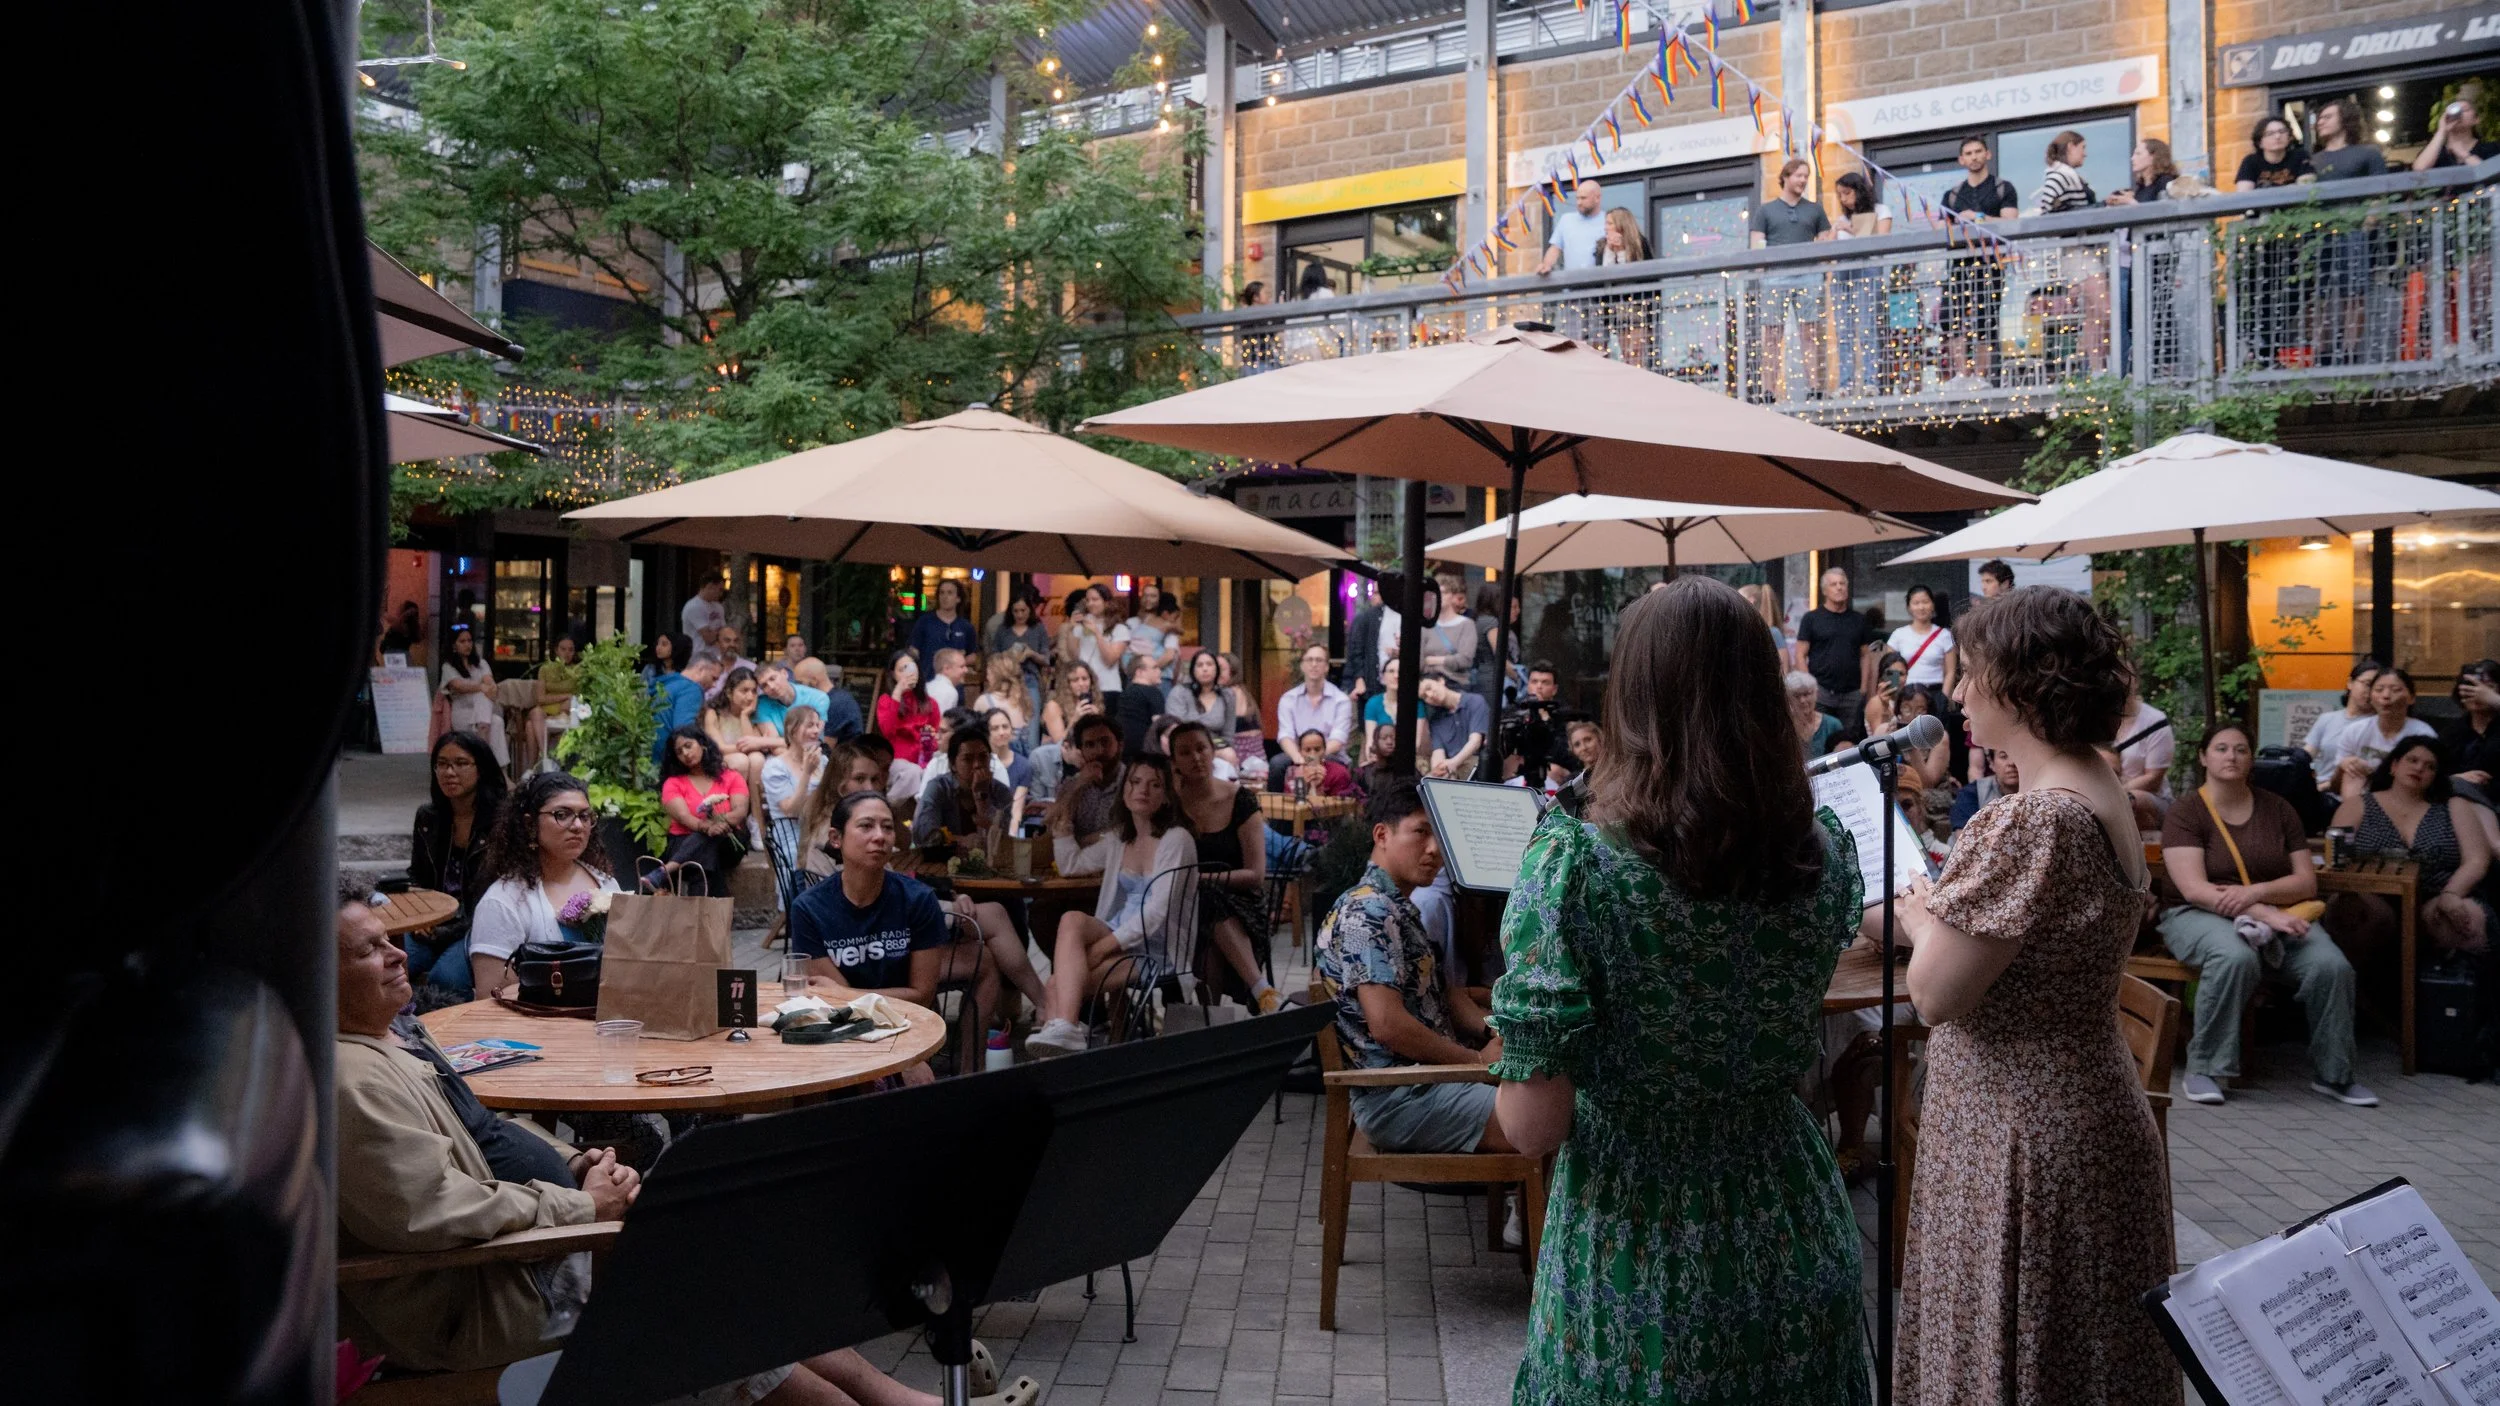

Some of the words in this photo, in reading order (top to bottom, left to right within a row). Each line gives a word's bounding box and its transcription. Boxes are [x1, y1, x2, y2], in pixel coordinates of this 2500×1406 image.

[2270, 41, 2325, 70] DIG
[2342, 22, 2444, 60] DRINK
[1873, 101, 1923, 125] ARTS
[1929, 99, 1943, 117] &
[1950, 85, 2032, 114] CRAFTS
[823, 933, 878, 949] NCOMMON
[730, 982, 745, 999] 11
